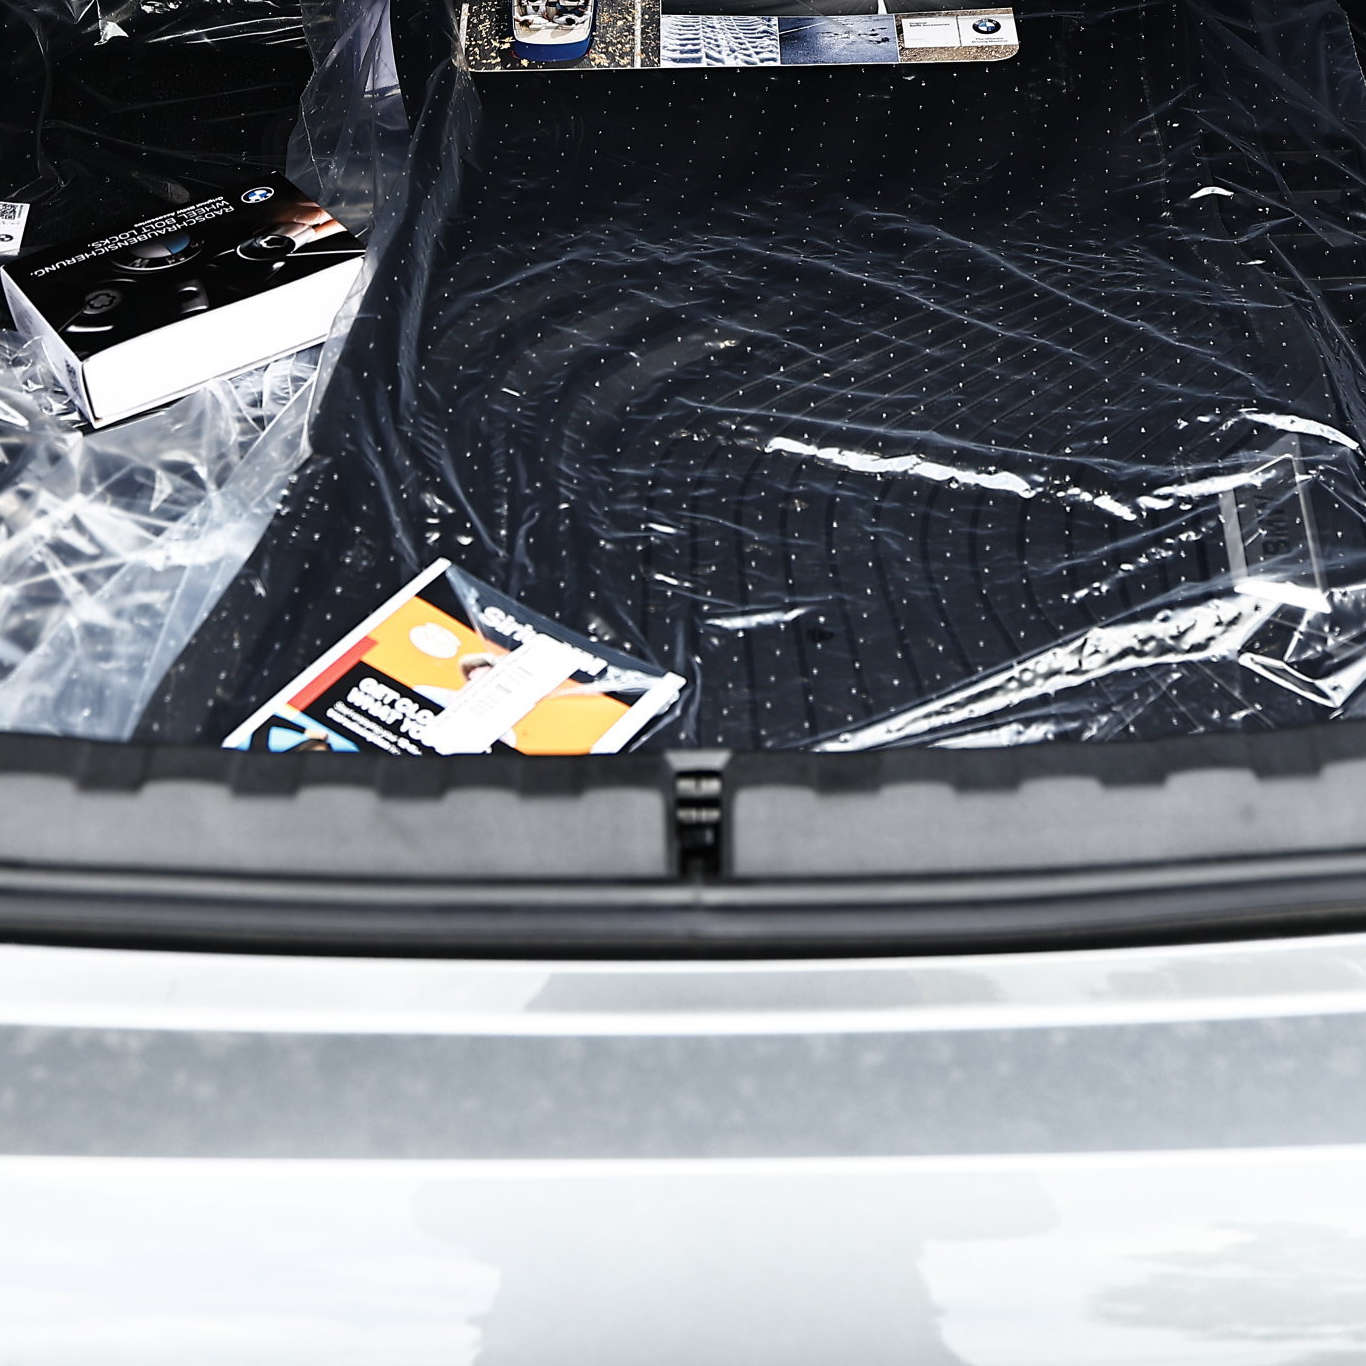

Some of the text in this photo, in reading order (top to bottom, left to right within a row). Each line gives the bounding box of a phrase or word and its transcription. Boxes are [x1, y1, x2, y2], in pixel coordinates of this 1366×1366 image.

[30, 205, 234, 277] RADSCHRAUBENSICHERUNG.
[87, 200, 229, 249] WHEEL BOLT LOCKS.
[346, 686, 403, 725] WHAT
[359, 677, 401, 704] GET
